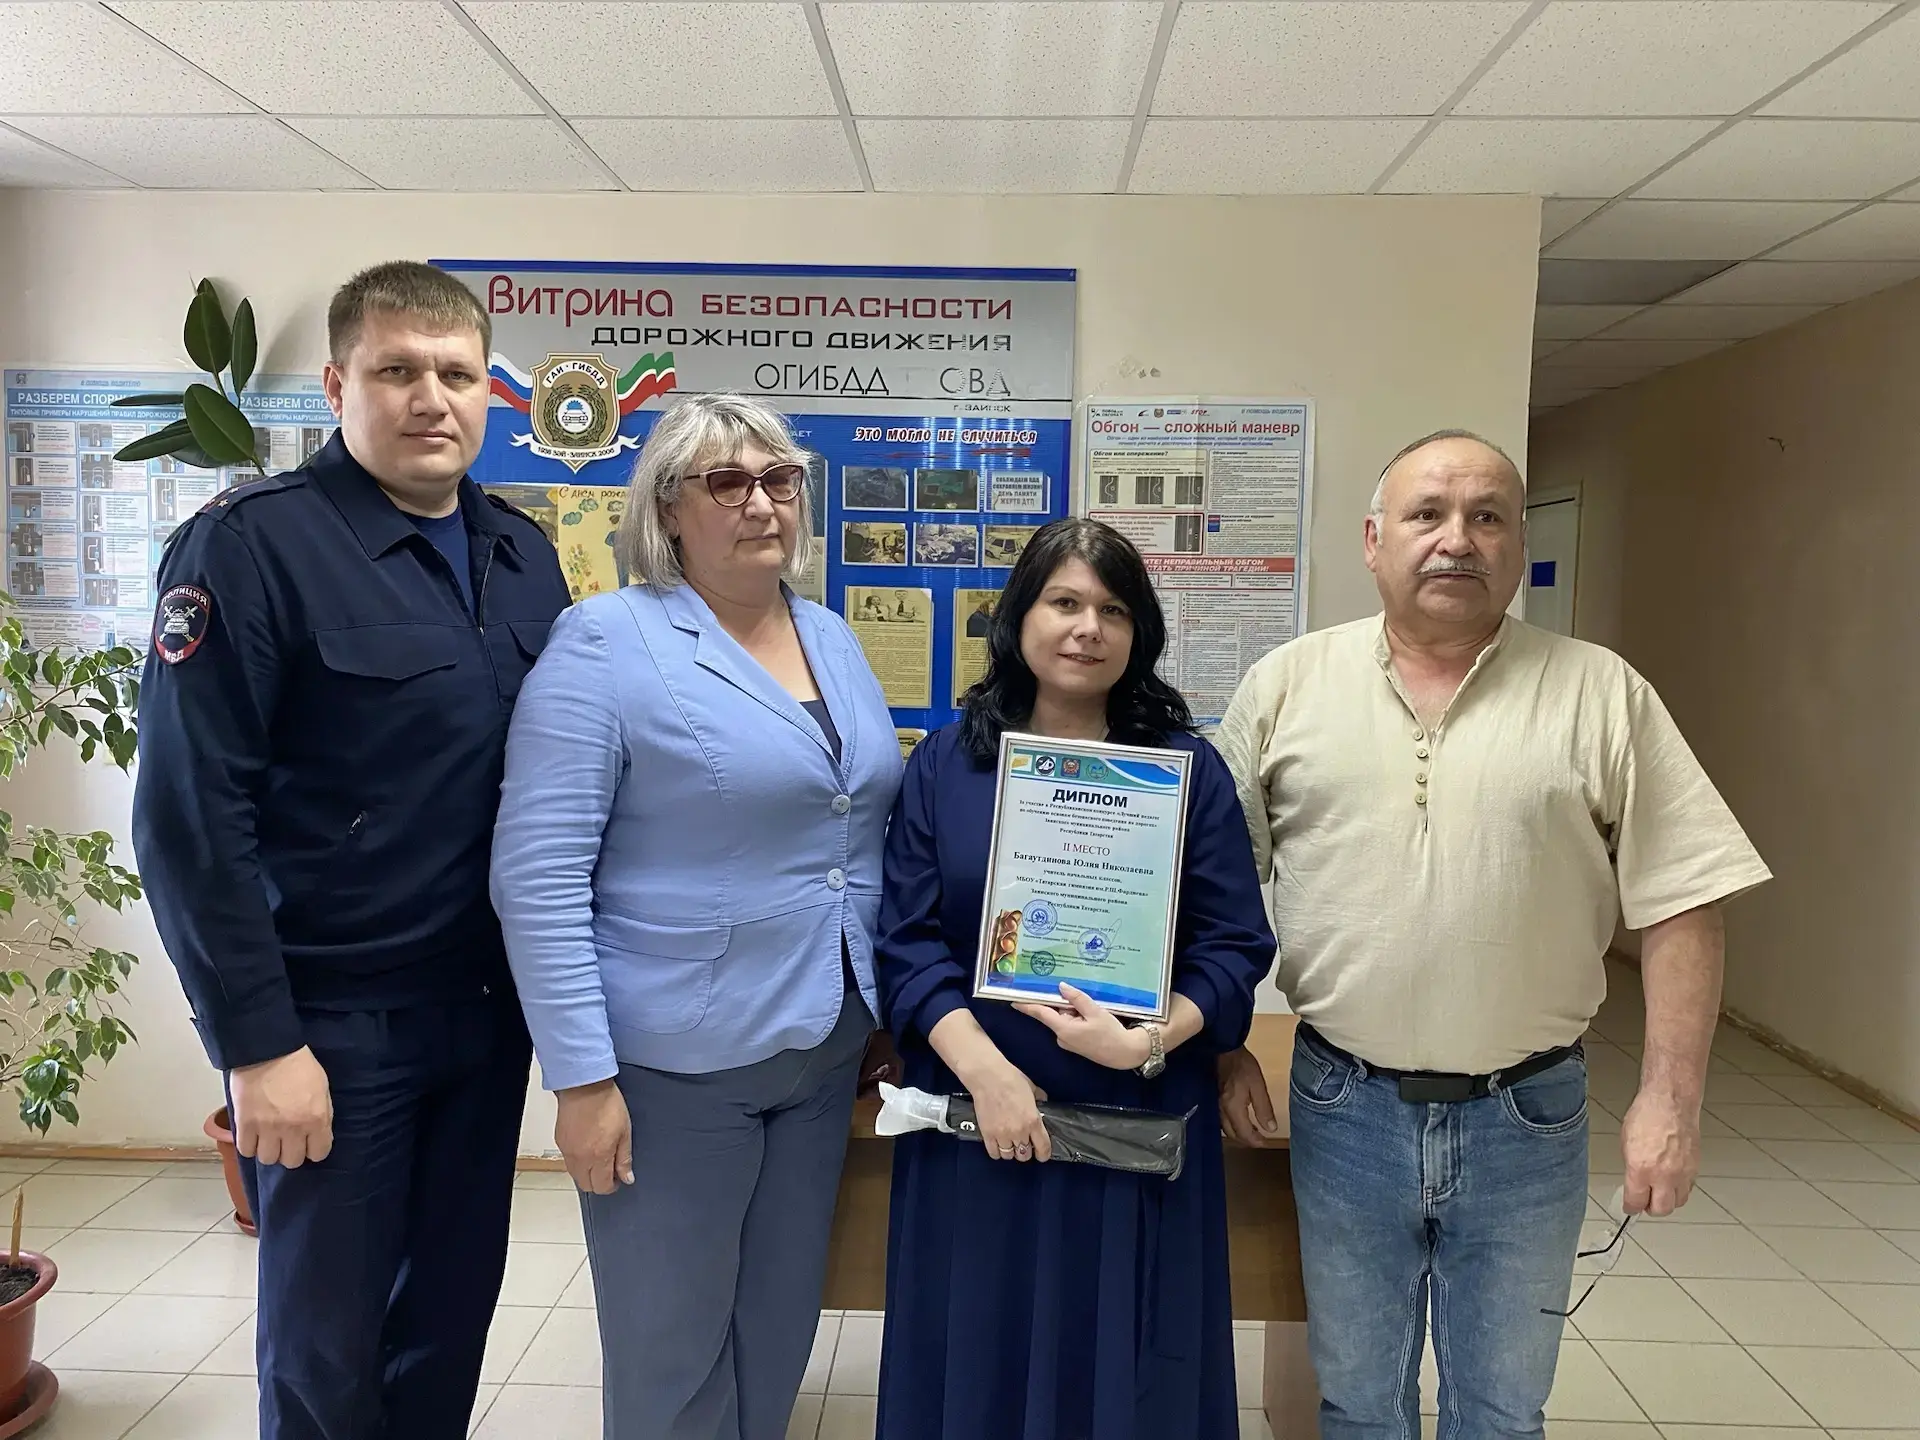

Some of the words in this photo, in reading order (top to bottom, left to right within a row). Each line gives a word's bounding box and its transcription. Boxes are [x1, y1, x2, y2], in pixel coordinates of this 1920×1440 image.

[488, 275, 673, 327] Витрина
[701, 294, 1012, 320] БЕЗОПАСНОСТИ
[591, 327, 813, 347] ДОРОЖНОГО
[825, 332, 1012, 351] ДВИЖЕНИЯ
[546, 366, 564, 384] ГАИ
[572, 363, 605, 386] ГИБДД
[754, 363, 889, 396] ОГИБДД
[18, 392, 80, 404] РАЗБЕРЕМ
[240, 397, 300, 408] РАЗБЕРЕМ
[72, 409, 110, 417] НАРУШЕНИЙ
[856, 426, 882, 442] ЭТО
[886, 428, 932, 443] МОГЛО
[937, 428, 954, 442] НЕ
[961, 428, 1037, 444] СЛУЧИТЬСЯ
[1091, 420, 1139, 434] Обгон
[1164, 420, 1237, 434] сложный
[1242, 423, 1300, 436] маневр
[160, 587, 208, 606] ПОЛИЦИЯ
[164, 650, 184, 663] МВД
[1052, 788, 1128, 808] ДИПЛОМ
[1063, 842, 1070, 852] II
[1072, 844, 1110, 856] МЕСТО
[1014, 852, 1071, 865] Багаутдинова
[1074, 858, 1100, 869] Юлия
[1102, 862, 1154, 876] Николаевна
